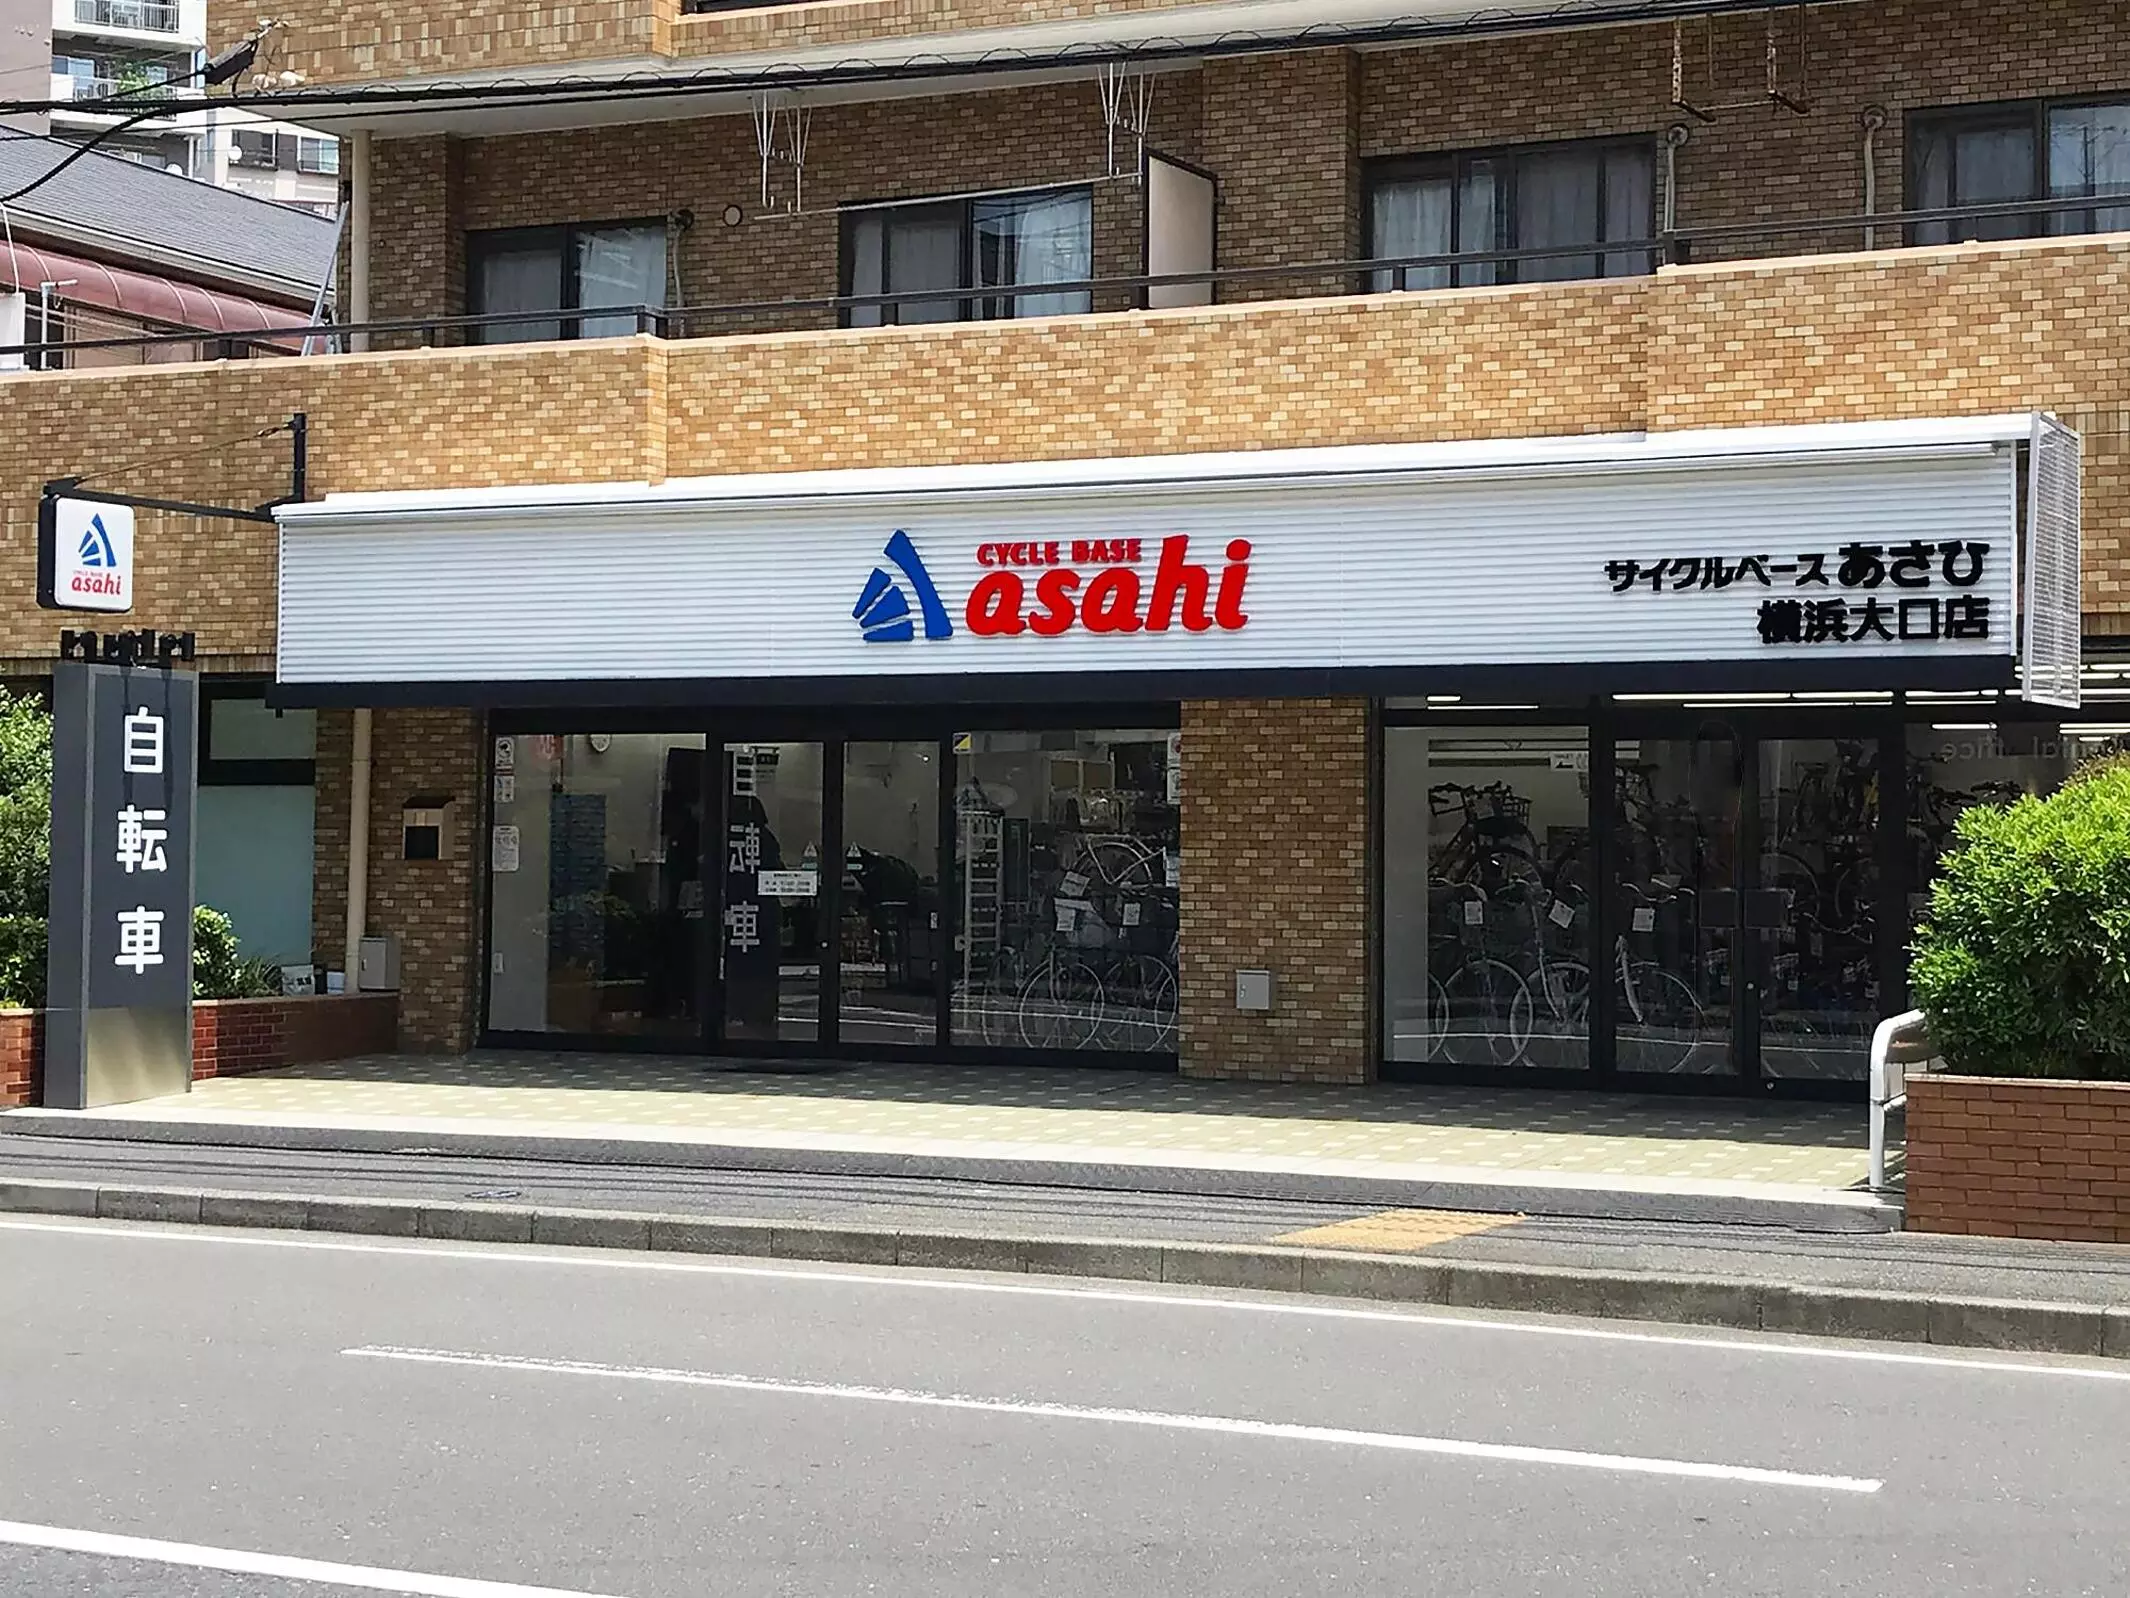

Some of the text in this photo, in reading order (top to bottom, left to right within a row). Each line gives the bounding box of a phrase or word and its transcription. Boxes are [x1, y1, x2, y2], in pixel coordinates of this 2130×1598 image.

[977, 538, 1142, 566] CYCLE BASE
[1605, 540, 1990, 592] サイクルベースあさひ
[71, 572, 121, 595] asahi
[965, 534, 1252, 636] asahi
[1757, 595, 1990, 643] 横浜大口店
[115, 706, 168, 974] 自転車
